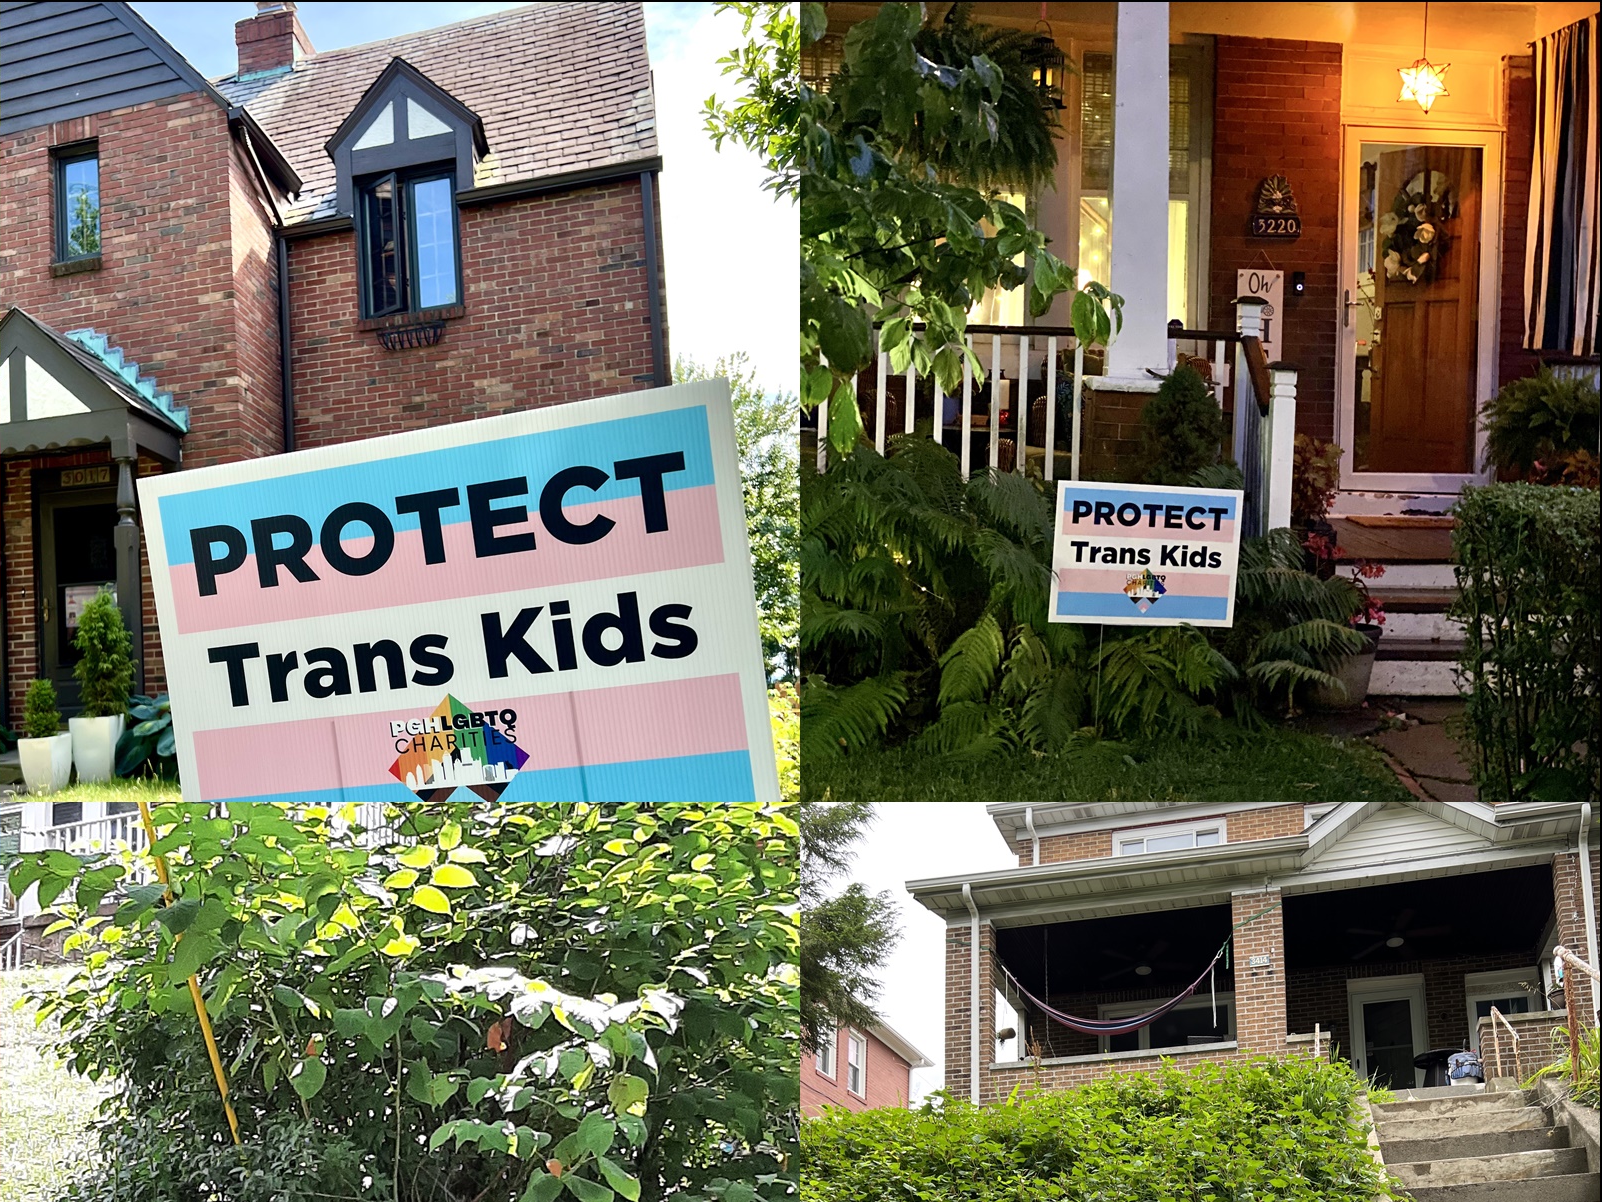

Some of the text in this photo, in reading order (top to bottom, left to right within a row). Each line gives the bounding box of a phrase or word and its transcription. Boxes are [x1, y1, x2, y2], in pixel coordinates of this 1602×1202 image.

[62, 467, 109, 485] 3017
[189, 451, 687, 598] PROTECT
[1072, 500, 1229, 531] PROTECT
[1070, 541, 1222, 568] Trans Kids
[209, 591, 699, 707] Trans Kids
[395, 728, 517, 754] CHARITIES
[1251, 955, 1268, 965] 3414
